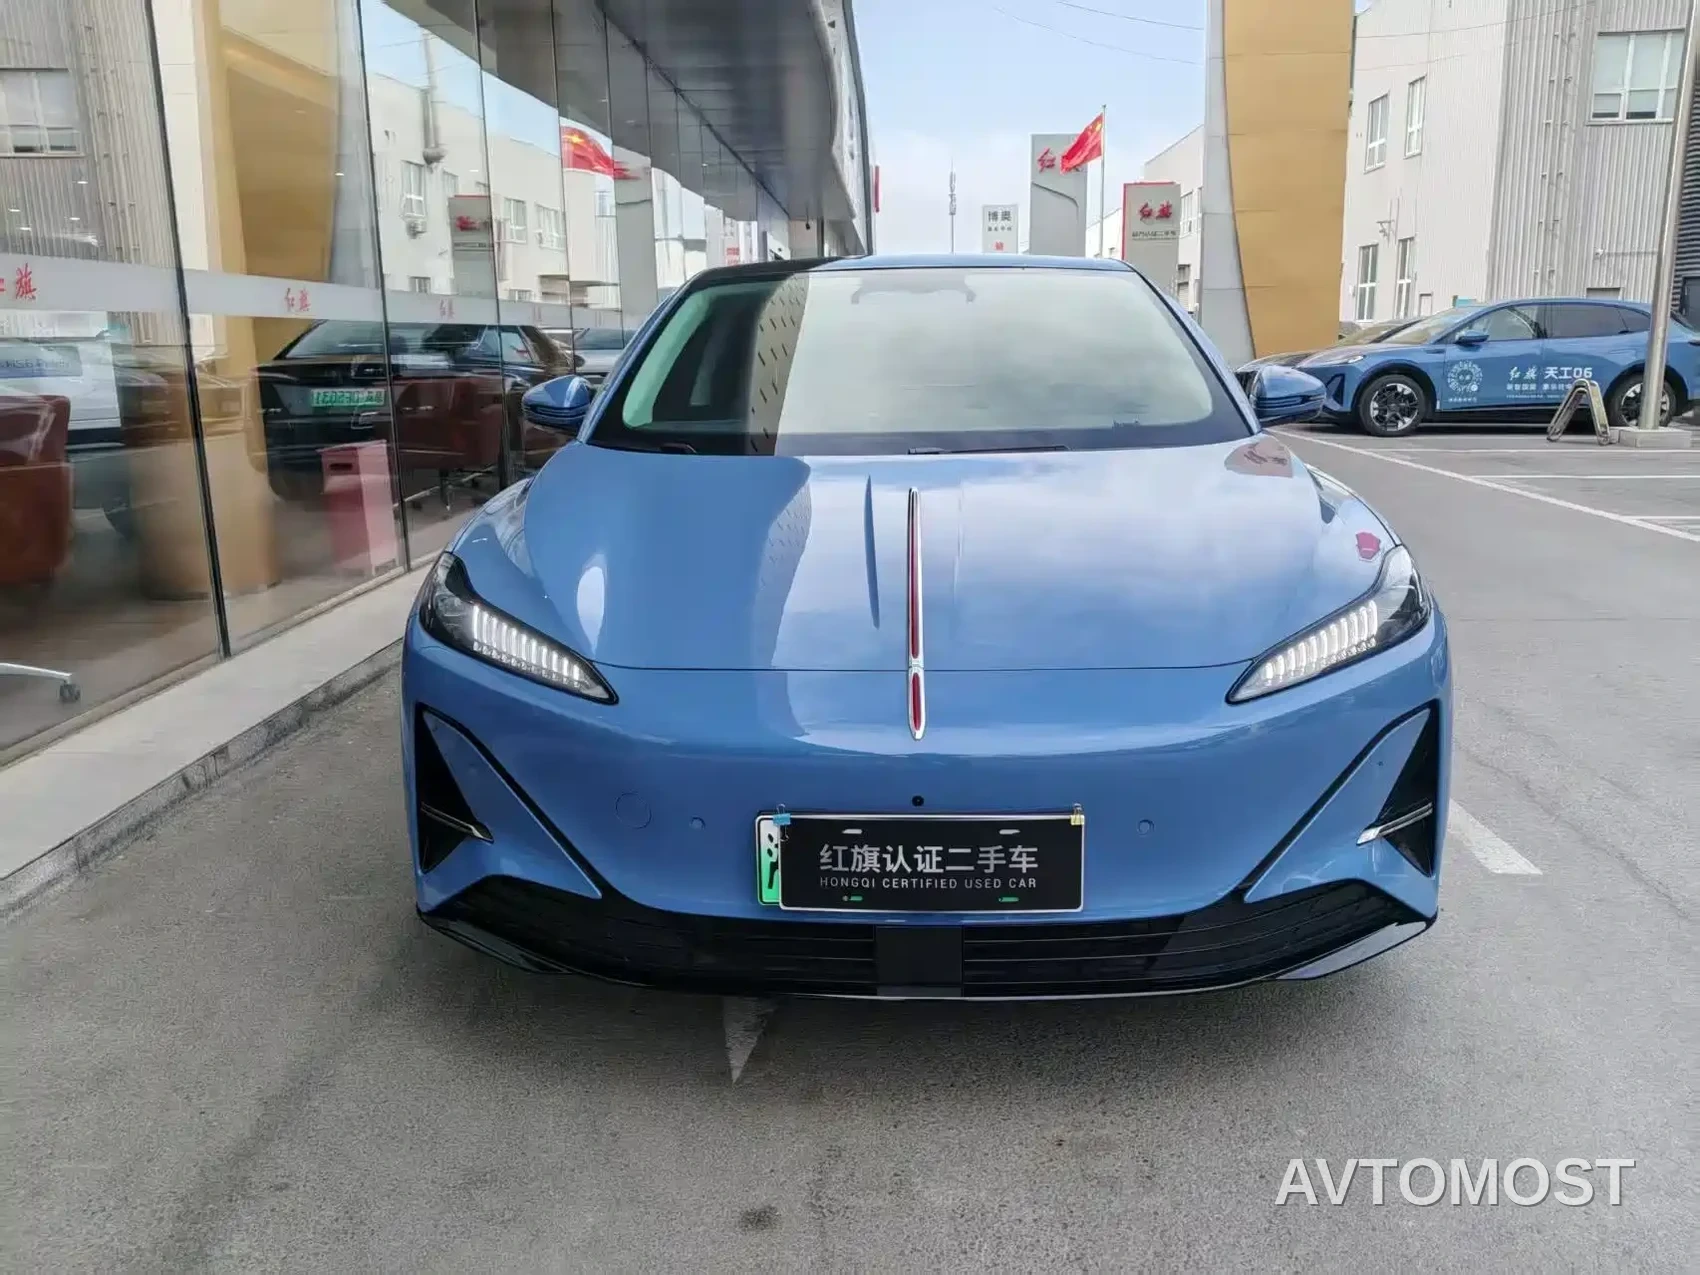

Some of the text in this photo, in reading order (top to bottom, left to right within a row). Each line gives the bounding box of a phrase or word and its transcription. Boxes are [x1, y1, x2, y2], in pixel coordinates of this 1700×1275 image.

[1139, 200, 1172, 221] 红旗
[1543, 366, 1593, 379] 天工06
[820, 844, 1038, 873] 红旗认证二手车
[820, 877, 1037, 889] HONGQI CERTIFIED USED CAR
